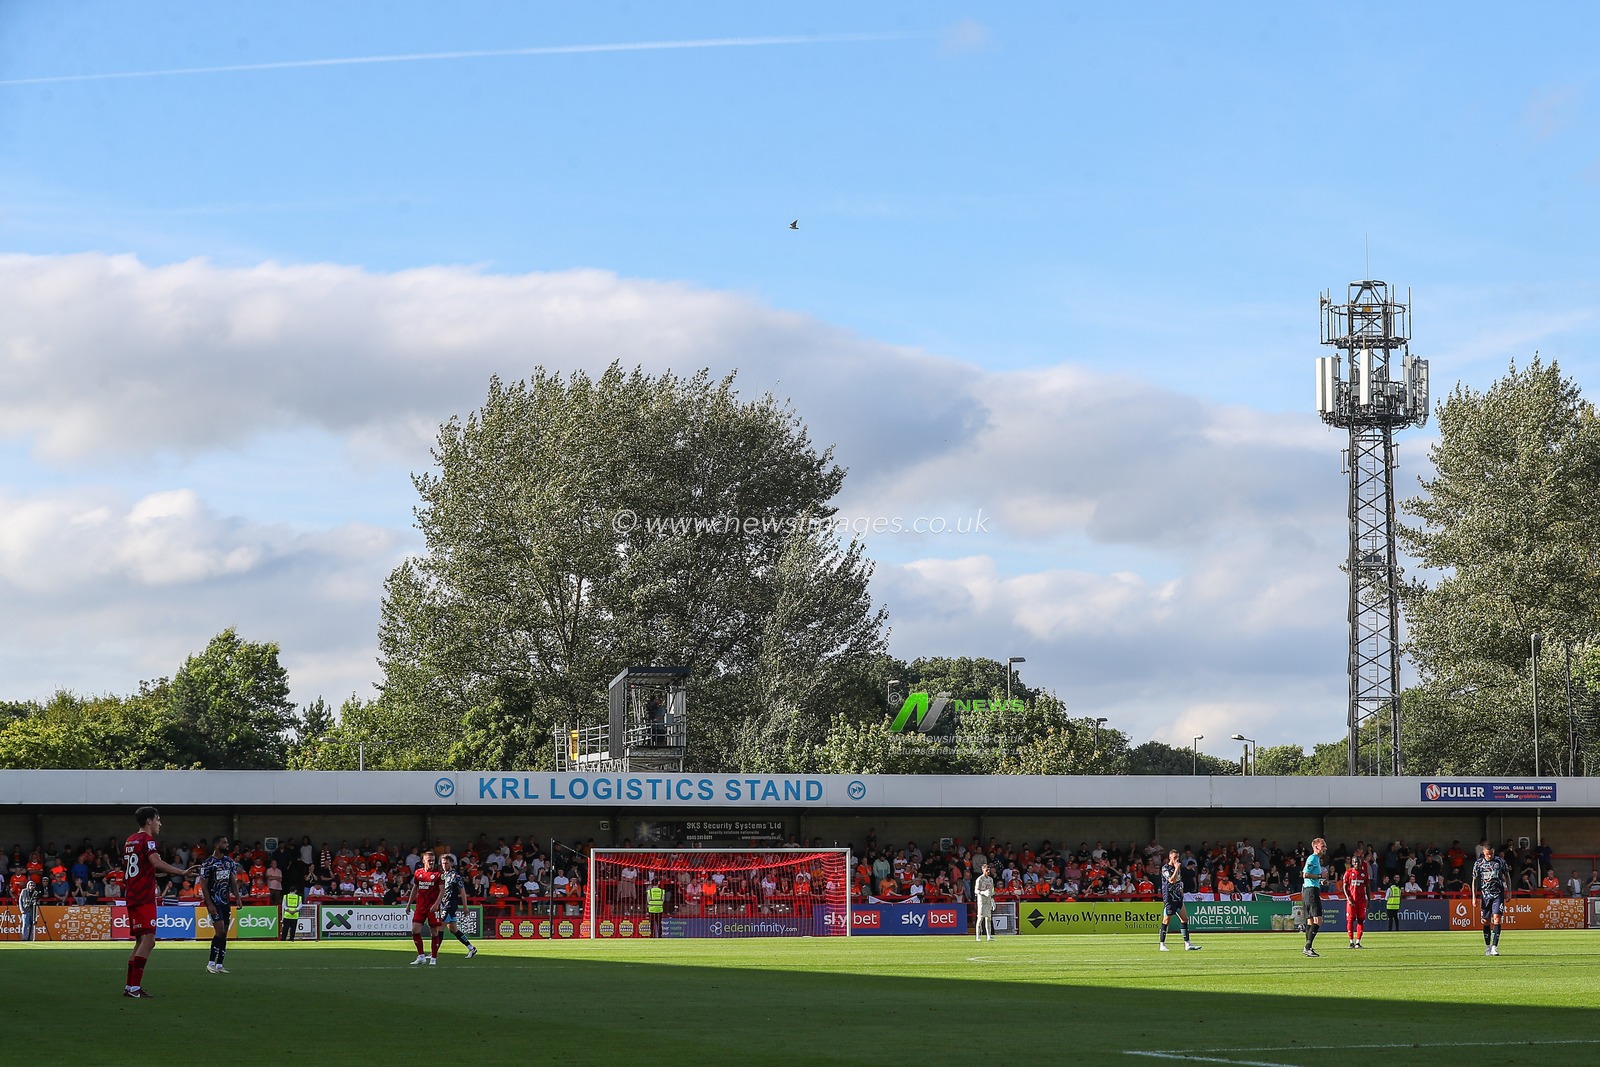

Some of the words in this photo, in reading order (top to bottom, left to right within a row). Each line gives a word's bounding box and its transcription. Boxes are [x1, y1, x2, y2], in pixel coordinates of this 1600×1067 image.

[479, 778, 539, 799] KRL
[550, 778, 714, 800] LOGISTICS
[725, 779, 823, 801] STAND
[1441, 786, 1484, 797] FULLER
[703, 822, 732, 830] Security
[735, 822, 766, 830] Systems
[357, 912, 408, 921] innovation
[1194, 906, 1250, 916] JAMESON,
[1368, 909, 1441, 922] edenfinity.com
[114, 915, 130, 928] eb
[156, 914, 193, 930] ebay
[198, 914, 235, 930] eby
[239, 914, 276, 930] ebay
[824, 912, 847, 927] sky
[854, 912, 877, 924] bet
[901, 911, 926, 927] sky
[931, 912, 954, 924] bet
[1048, 912, 1079, 925] Mayo
[1081, 912, 1122, 925] Wynne
[1125, 911, 1161, 921] Baxter
[1187, 916, 1223, 924] INGER
[1225, 916, 1232, 924] &
[1235, 916, 1258, 924] LIME
[1452, 918, 1470, 927] Kogo
[724, 922, 797, 934] edeninfinity.com
